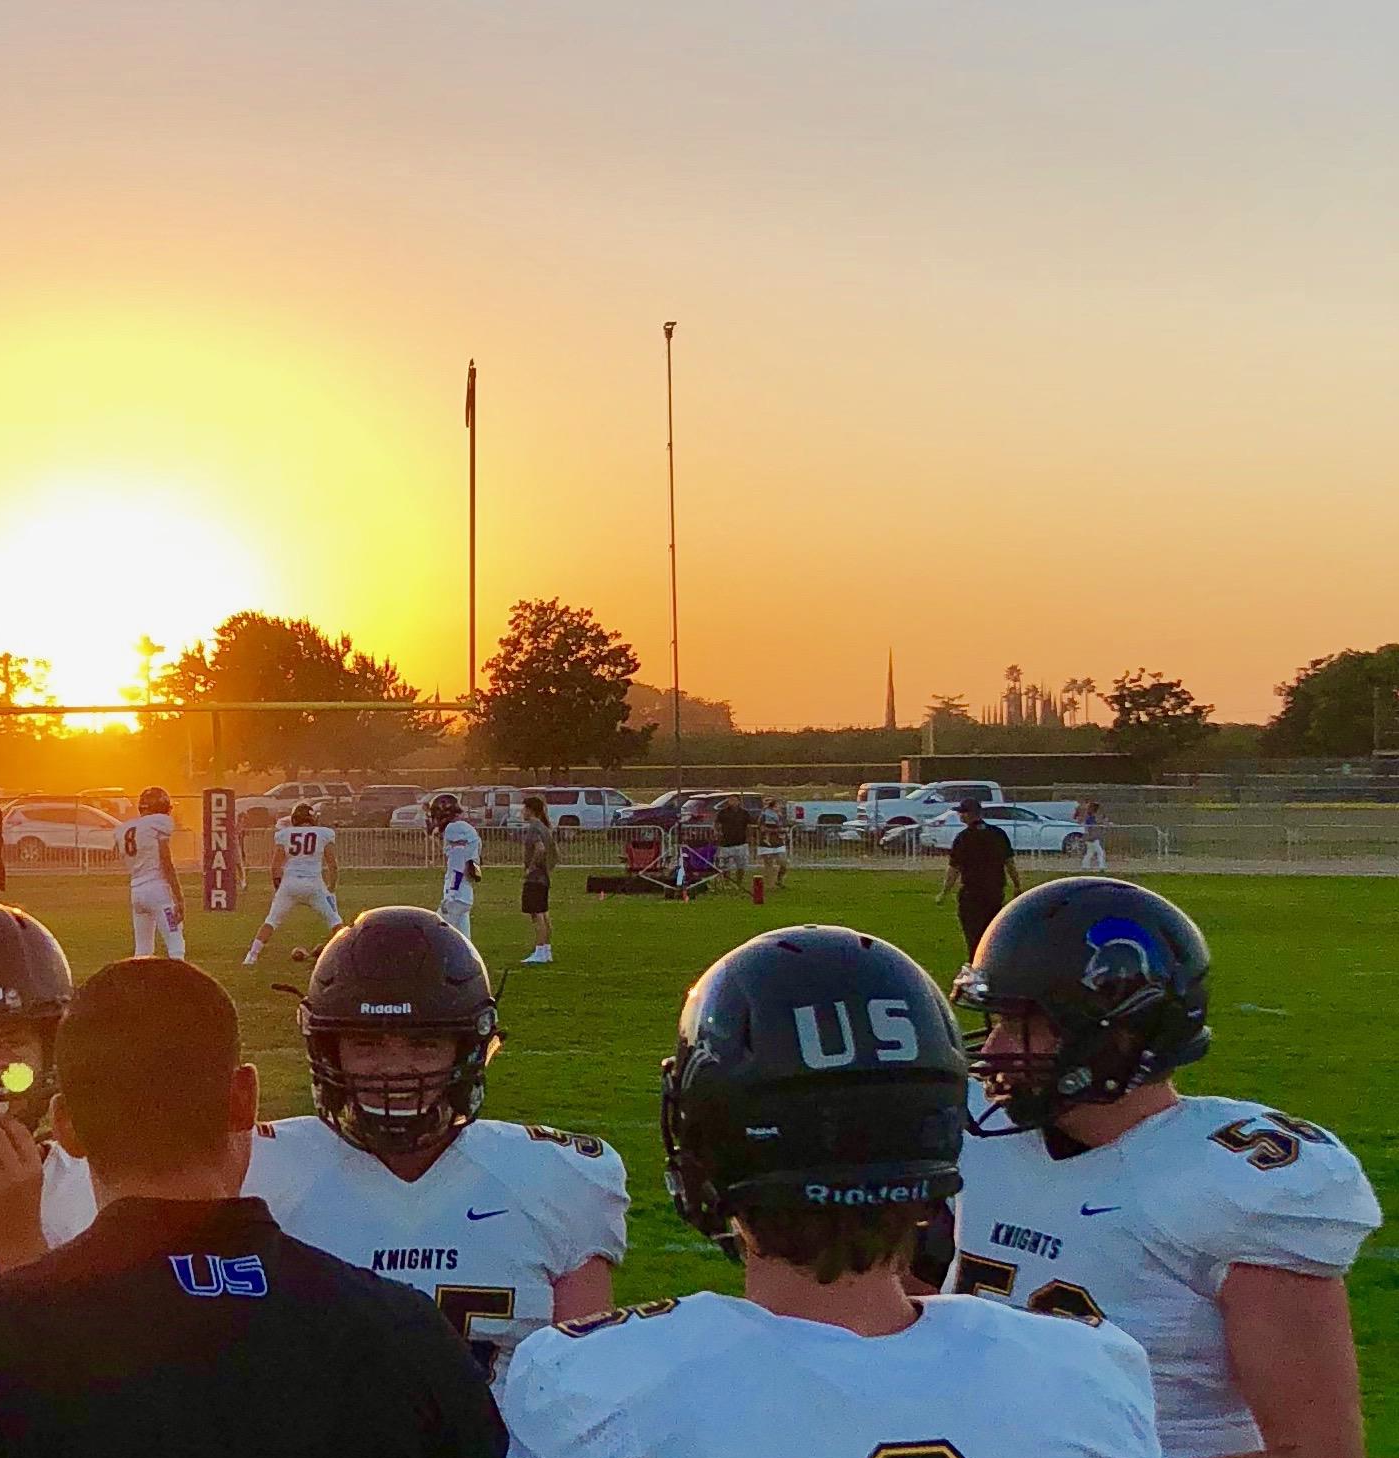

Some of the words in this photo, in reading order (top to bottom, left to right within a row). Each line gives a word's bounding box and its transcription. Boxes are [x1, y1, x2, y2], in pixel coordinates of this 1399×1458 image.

[124, 827, 138, 857] 8
[210, 792, 228, 909] DENAIR
[288, 832, 317, 856] 50
[360, 1002, 412, 1015] Riddell
[792, 999, 920, 1070] US
[990, 1221, 1062, 1260] KNIGHTS
[168, 1254, 268, 1297] US
[372, 1248, 459, 1271] KNIGHTS
